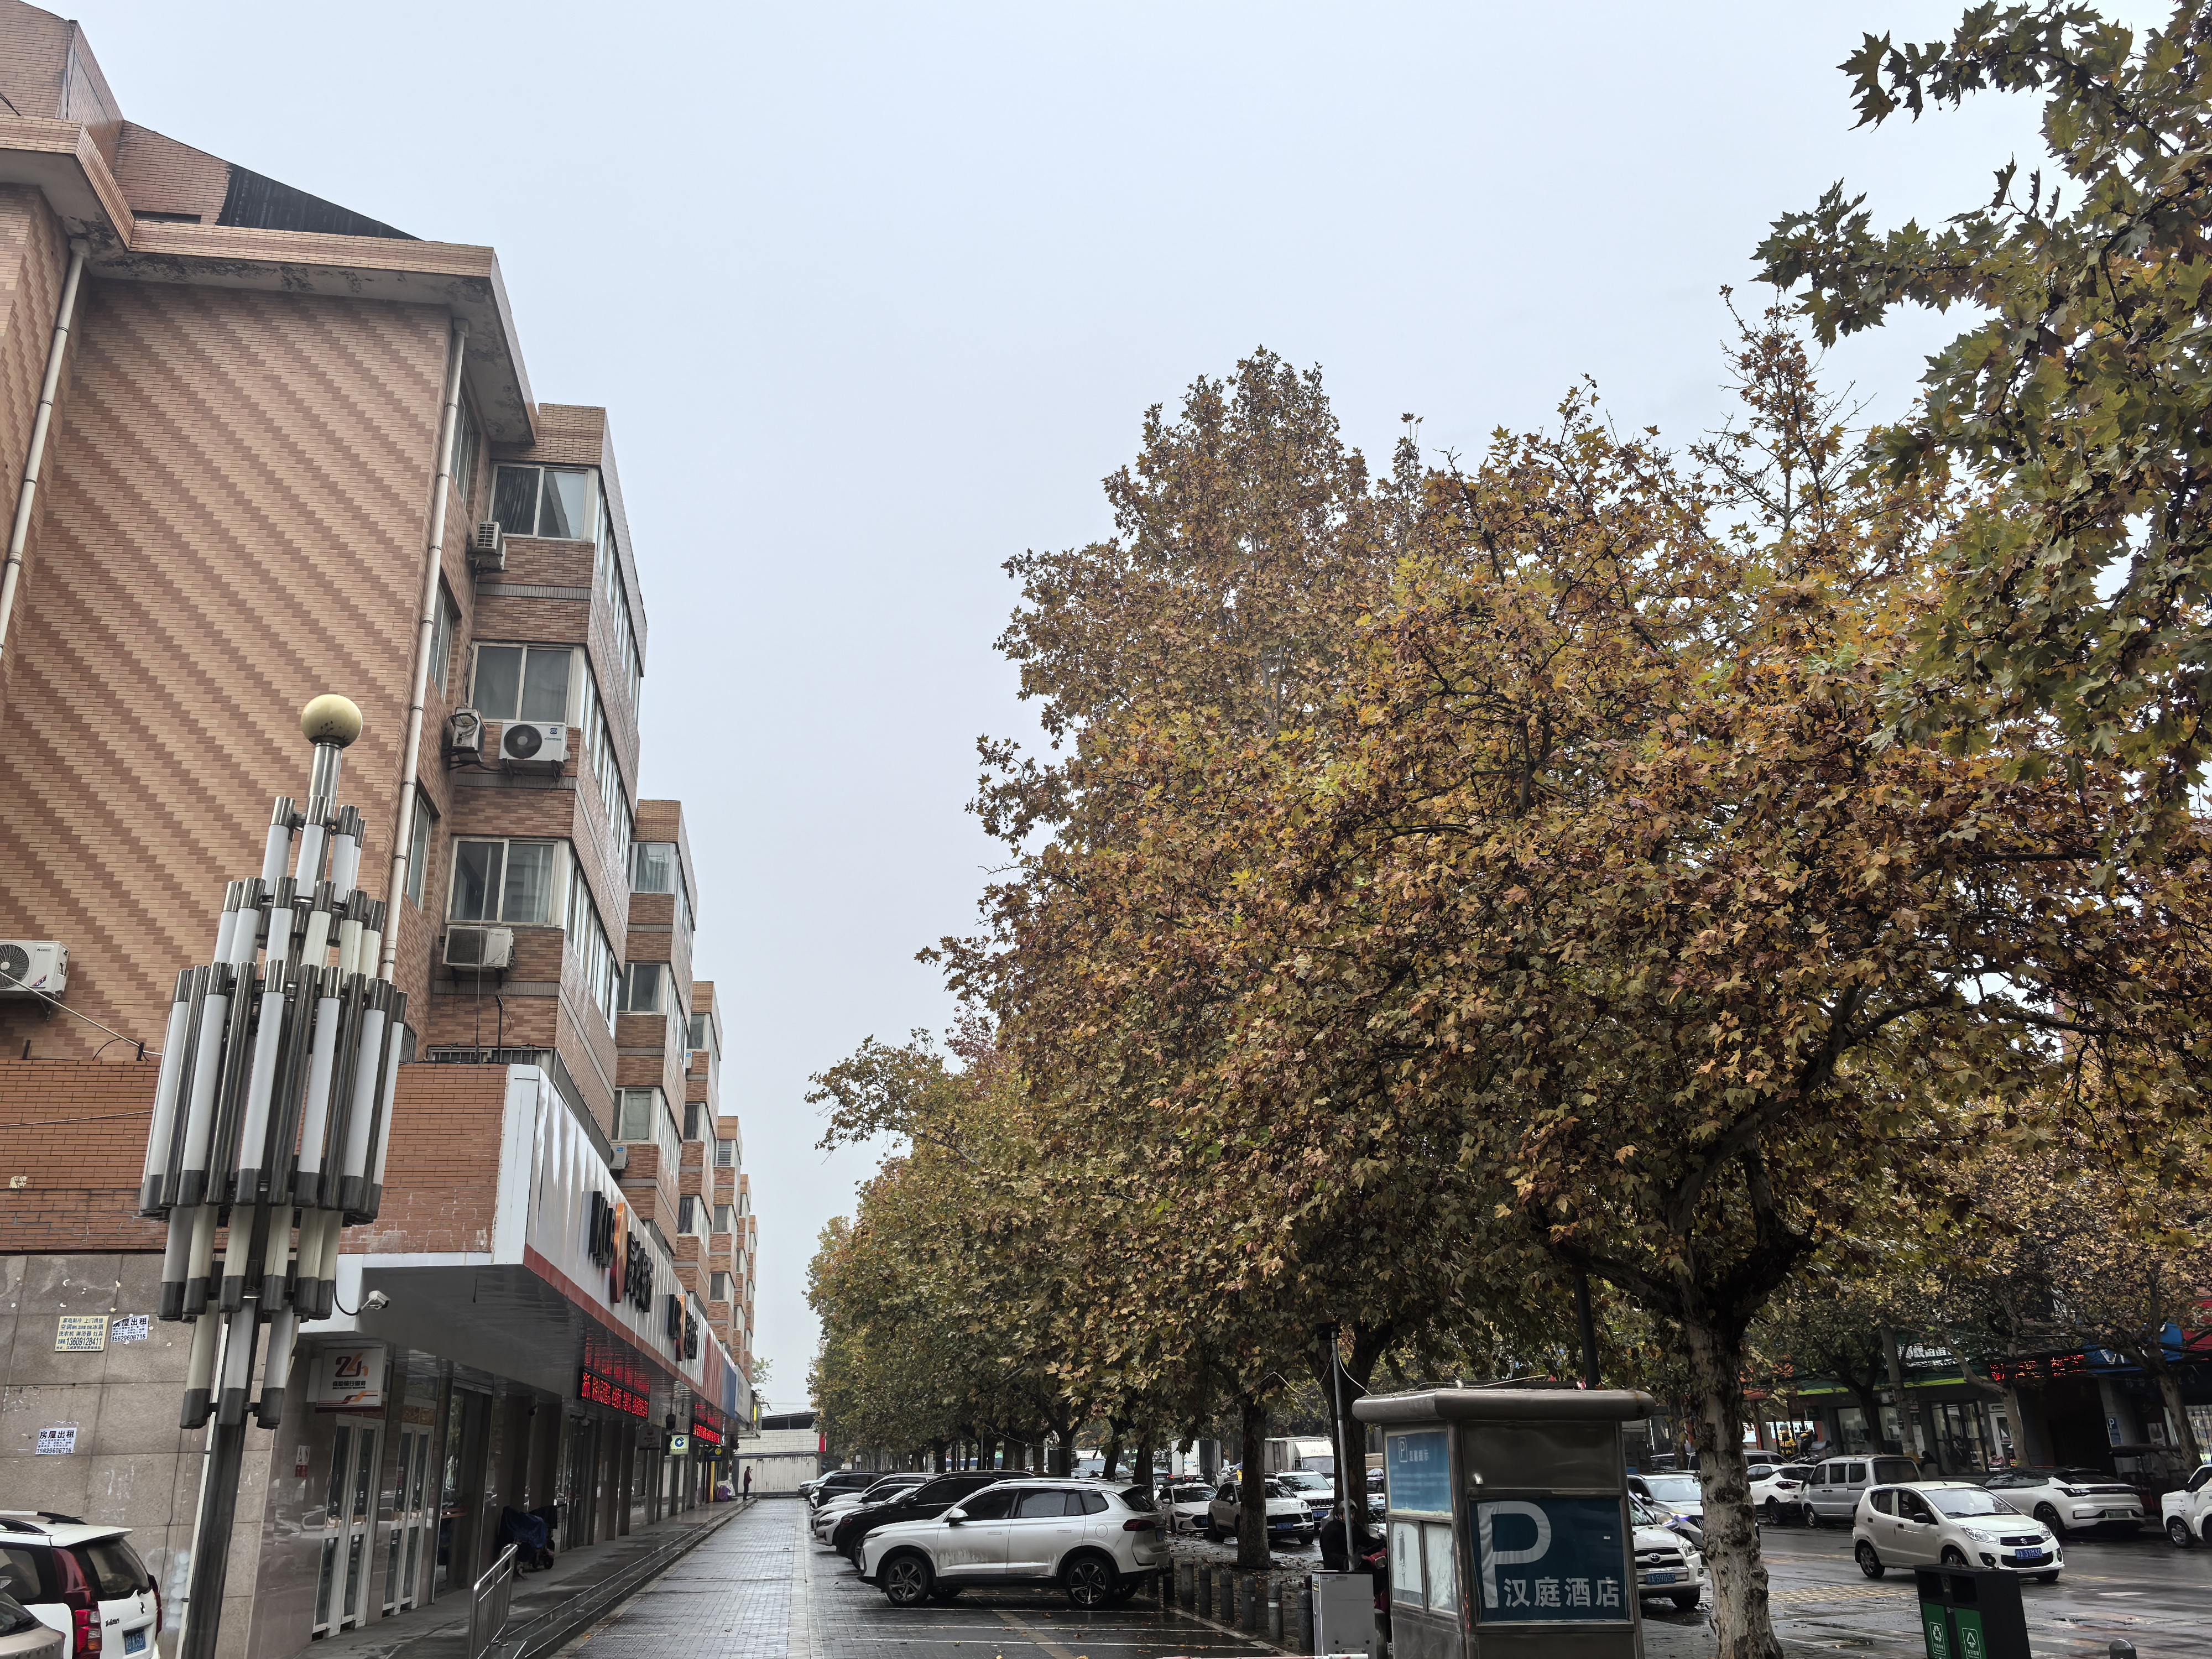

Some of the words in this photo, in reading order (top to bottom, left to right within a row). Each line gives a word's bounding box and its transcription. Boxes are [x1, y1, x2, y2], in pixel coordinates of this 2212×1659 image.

[40, 1431, 74, 1439] 房屋出租
[1477, 1501, 1551, 1608] P
[1504, 1577, 1620, 1607] 汉庭酒店
